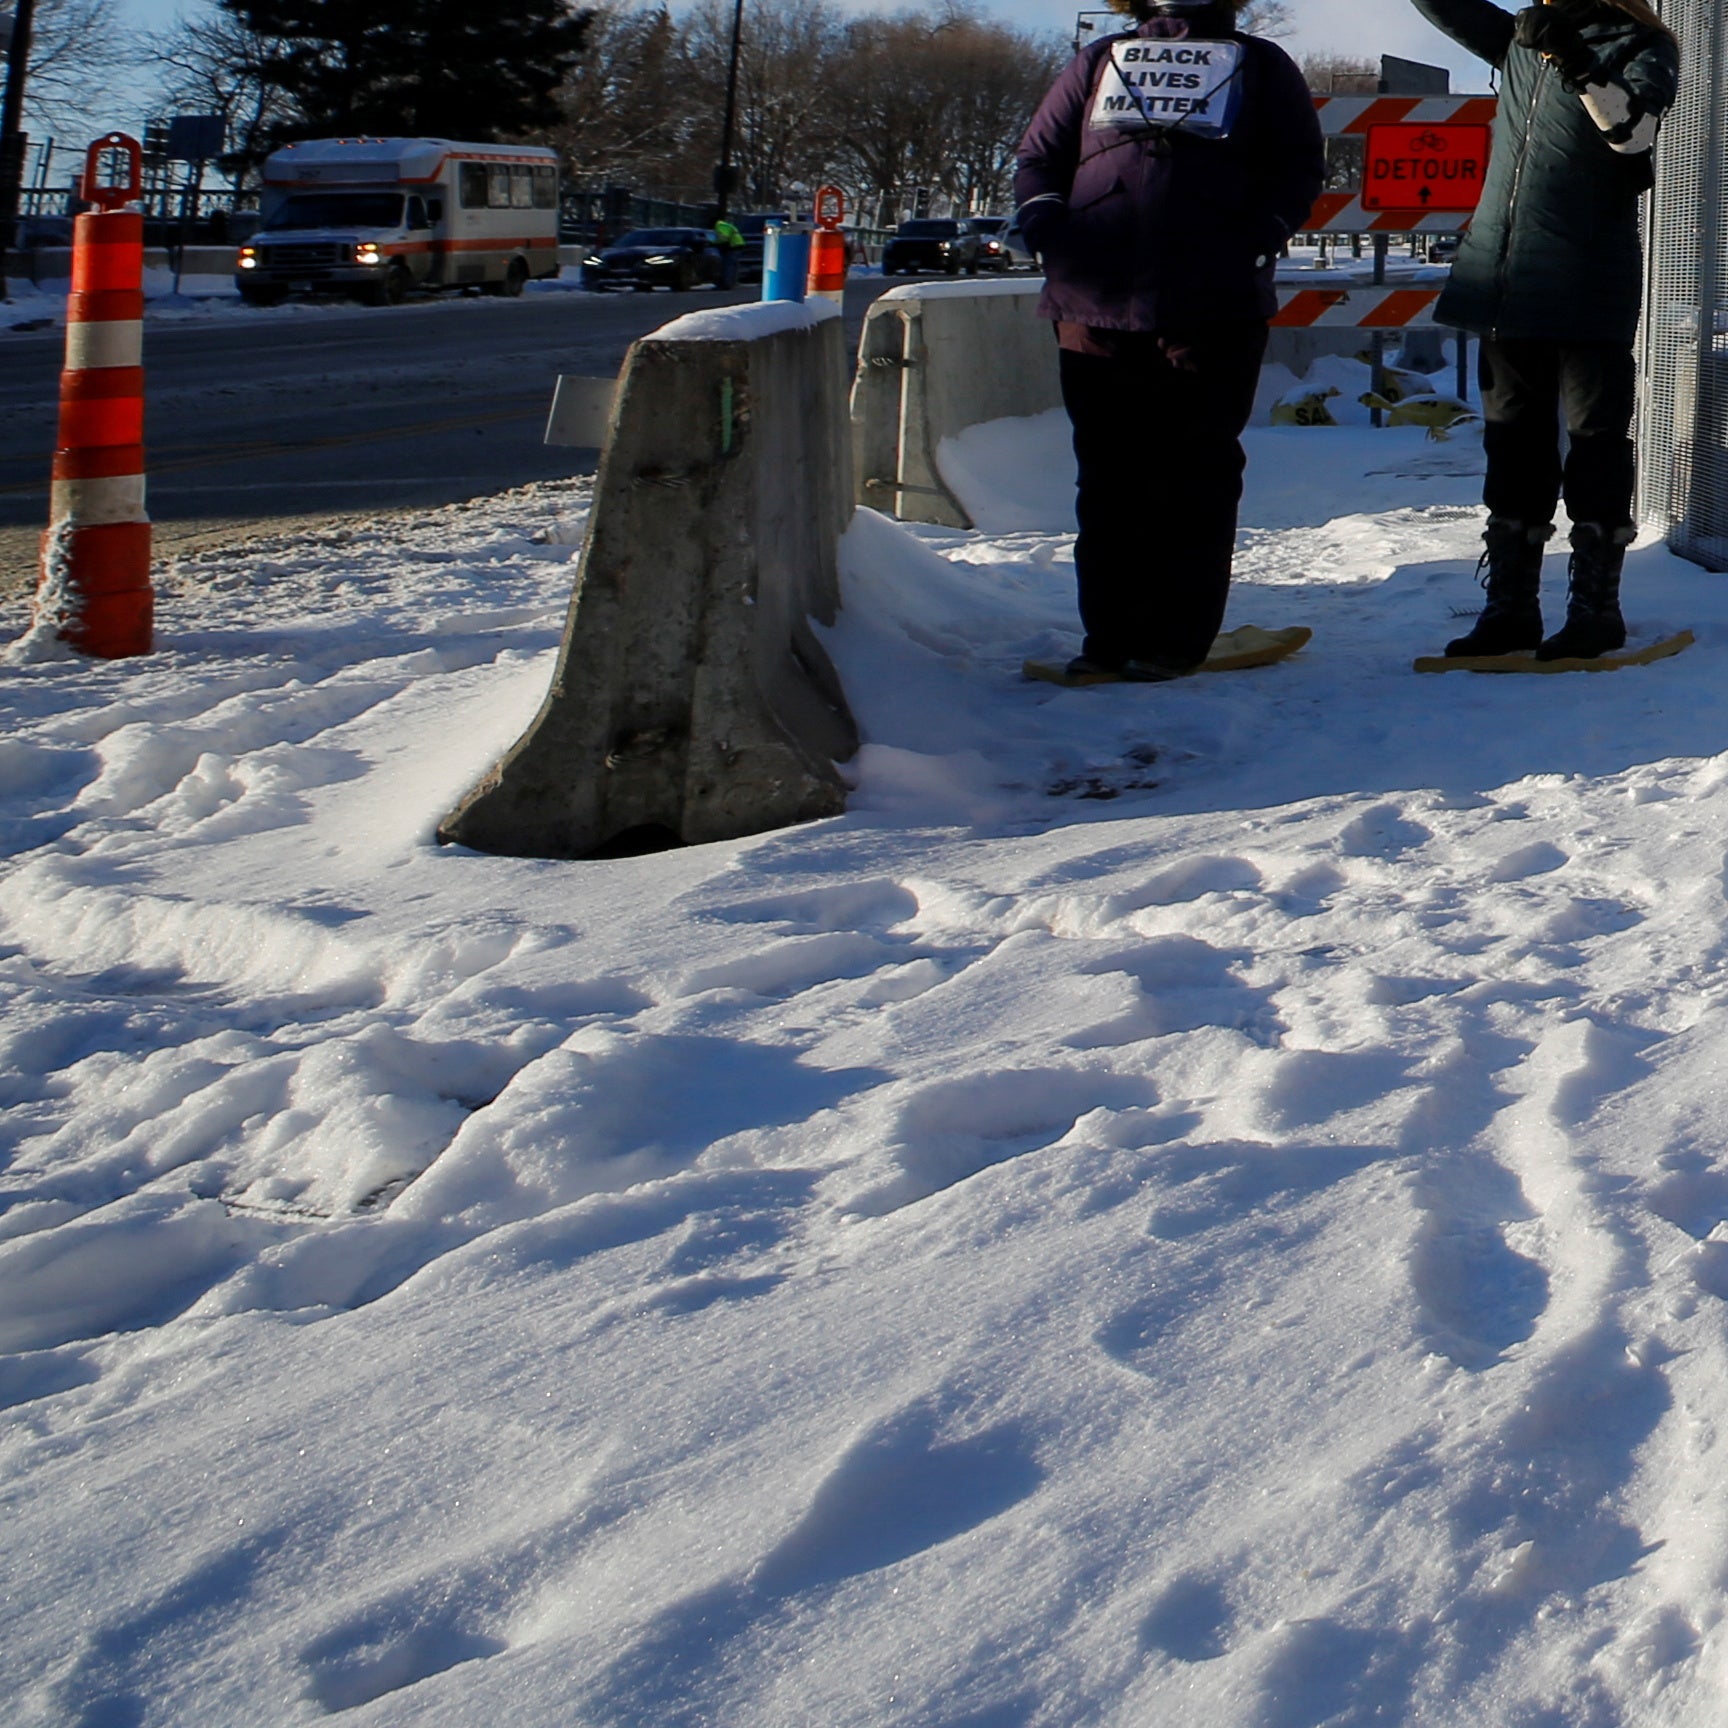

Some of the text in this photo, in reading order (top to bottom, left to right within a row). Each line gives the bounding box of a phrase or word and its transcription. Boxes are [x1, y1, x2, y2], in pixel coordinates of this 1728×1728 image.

[1123, 47, 1212, 66] BLACK
[1122, 71, 1201, 90] LIVES
[1103, 94, 1210, 115] MATTER
[1373, 158, 1478, 180] DETOUR
